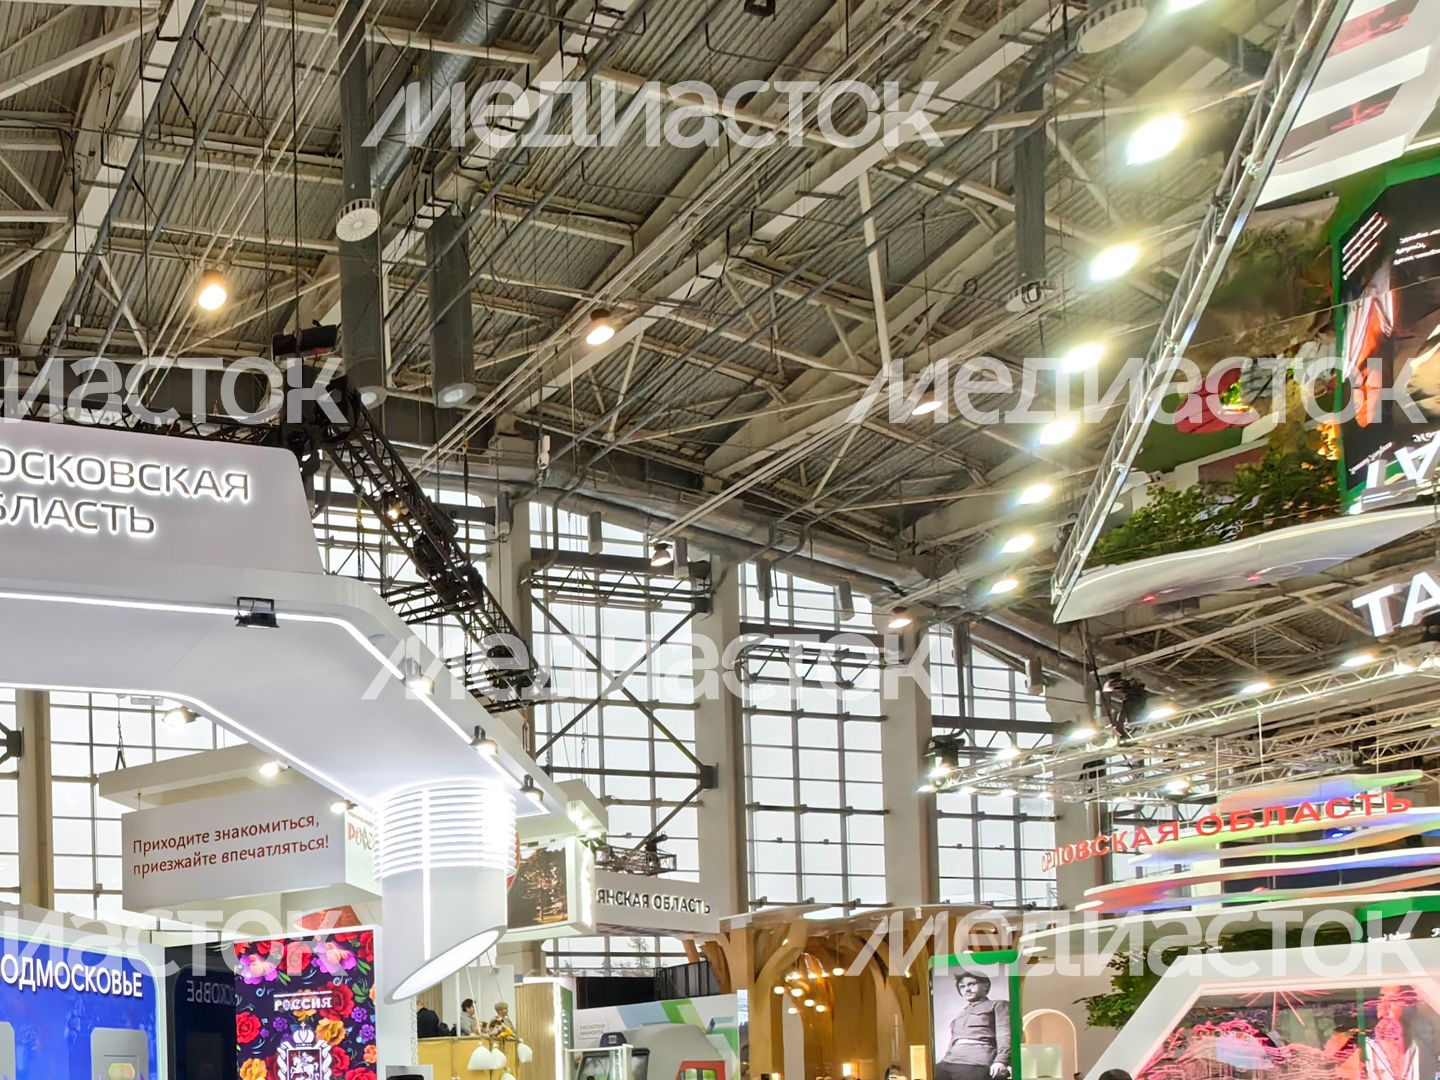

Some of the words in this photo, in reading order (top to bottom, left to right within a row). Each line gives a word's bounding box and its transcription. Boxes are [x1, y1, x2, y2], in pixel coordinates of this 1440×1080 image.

[133, 832, 210, 857] Приходите
[214, 814, 320, 842] знакомиться,
[1041, 821, 1180, 873] ОРЛОВСКАЯ
[1195, 790, 1413, 835] ОБЛАСТЬ
[133, 852, 217, 879] приезжайте
[221, 834, 330, 863] впечатляться!
[653, 894, 711, 914] ОБЛАСТЬ
